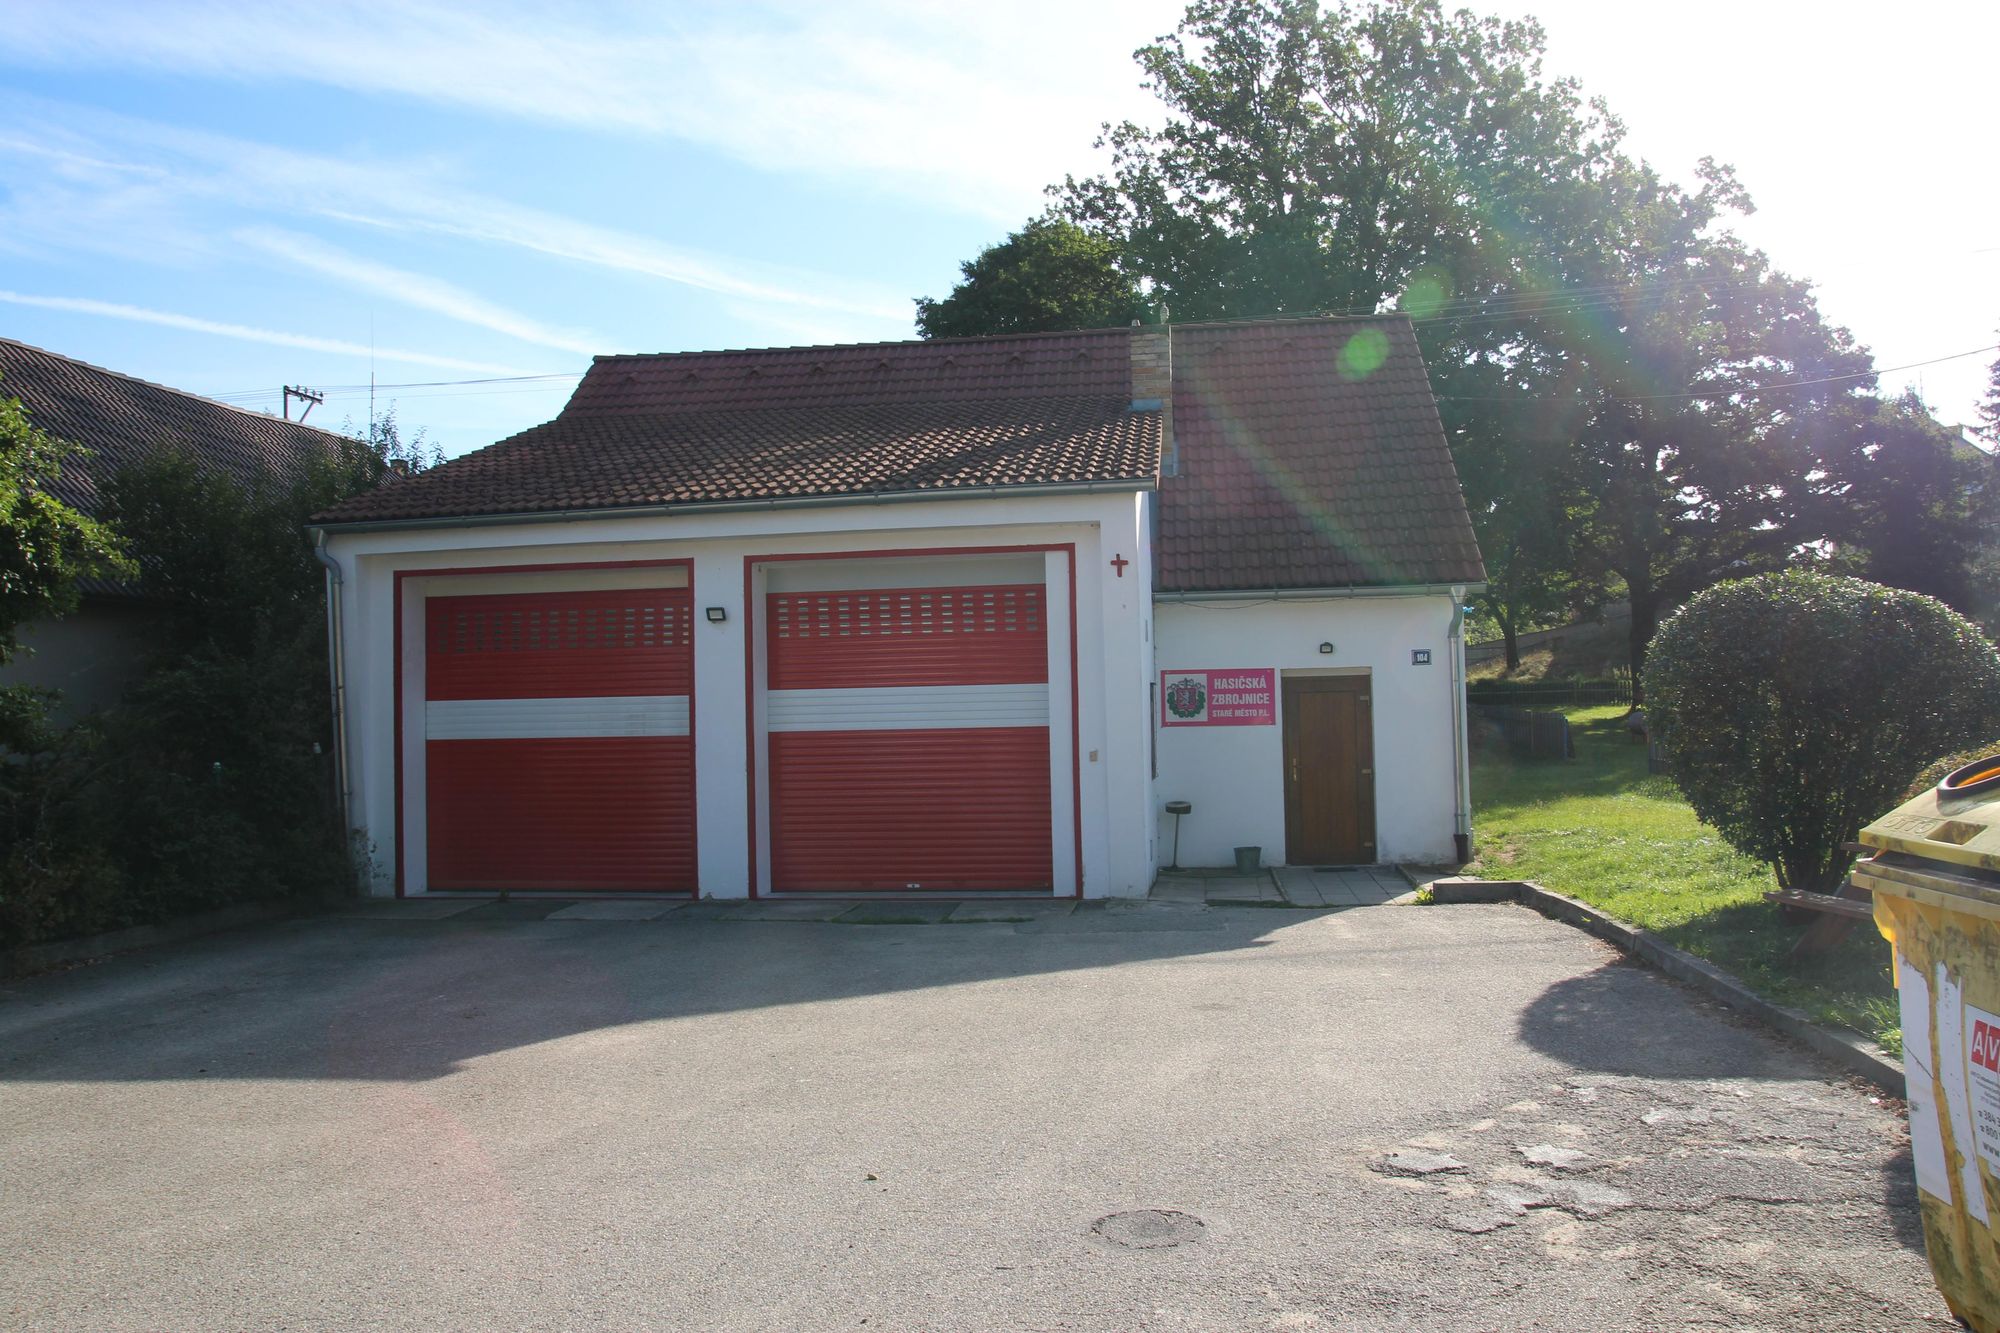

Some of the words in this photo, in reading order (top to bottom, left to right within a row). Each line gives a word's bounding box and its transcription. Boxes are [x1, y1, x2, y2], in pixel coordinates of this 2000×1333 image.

[1214, 675, 1267, 689] HASIČSKÁ
[1212, 693, 1270, 705] ZBROJNICE
[1212, 709, 1233, 717] STARÉ
[1235, 708, 1258, 717] MĚSTO
